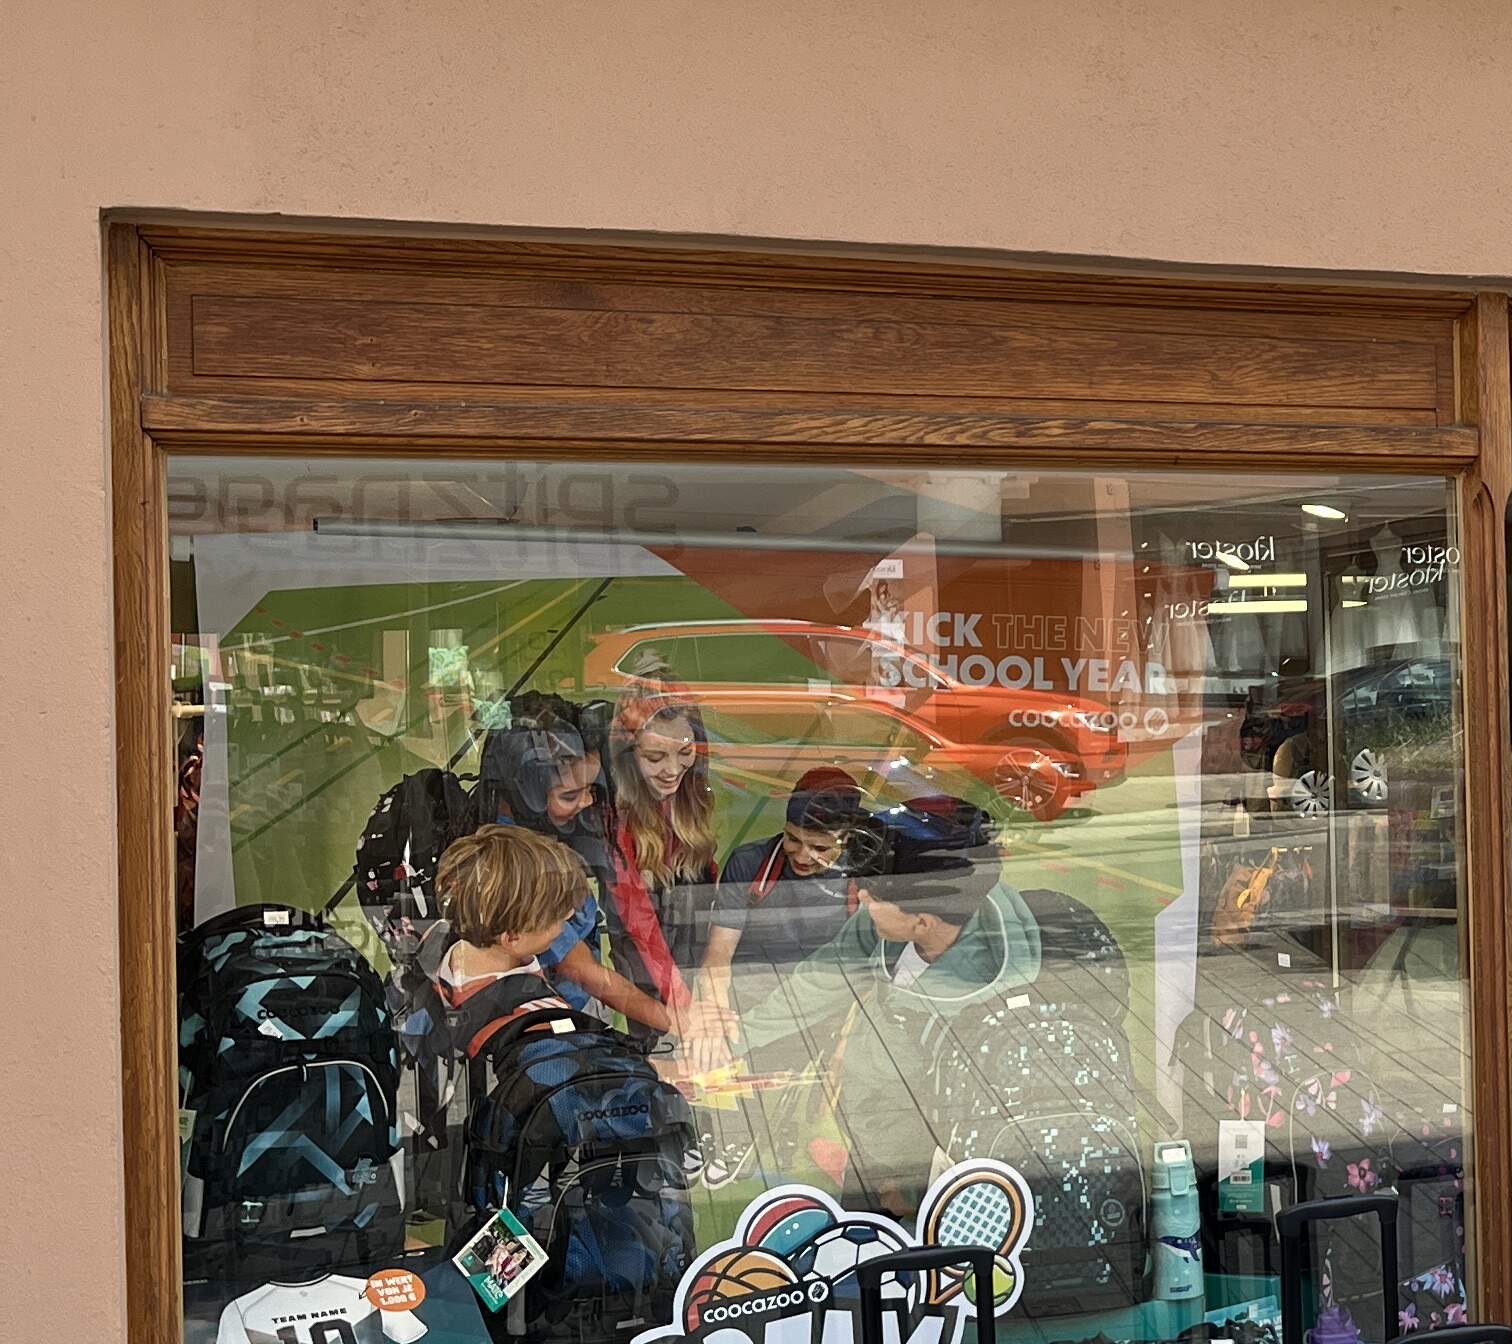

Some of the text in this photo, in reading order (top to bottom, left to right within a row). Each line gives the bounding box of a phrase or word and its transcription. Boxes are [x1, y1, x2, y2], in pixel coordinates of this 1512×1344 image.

[879, 611, 1171, 656] KICK THE NEW
[879, 654, 1170, 694] SCHOOL YEAR
[271, 1307, 348, 1325] TEAM NAME
[703, 1289, 804, 1323] coocazoo
